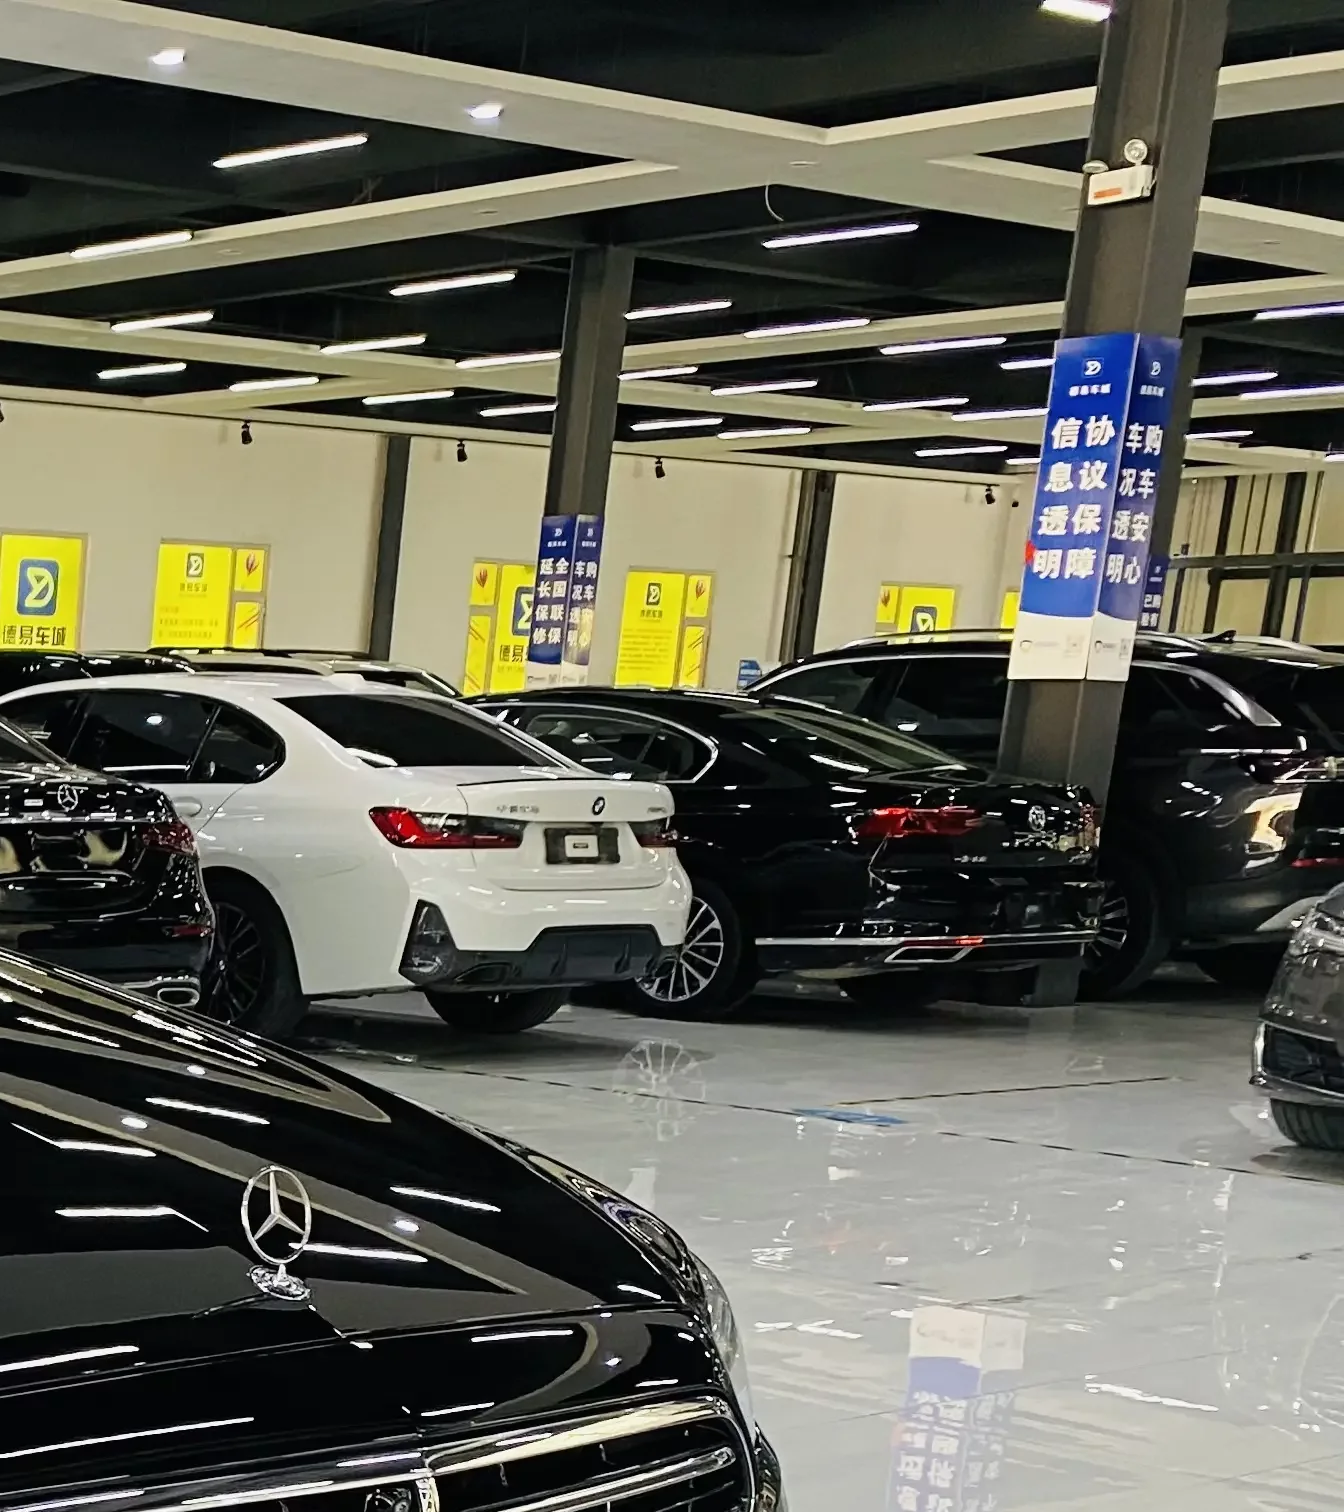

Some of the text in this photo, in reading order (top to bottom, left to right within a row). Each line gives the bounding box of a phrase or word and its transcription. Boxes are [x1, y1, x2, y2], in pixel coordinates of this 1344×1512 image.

[1033, 417, 1083, 579] 信息透明
[1064, 414, 1116, 579] 协议保障
[1106, 422, 1145, 583] 车况透明
[1124, 424, 1164, 584] 购车安心
[3, 625, 67, 645] 德易车城
